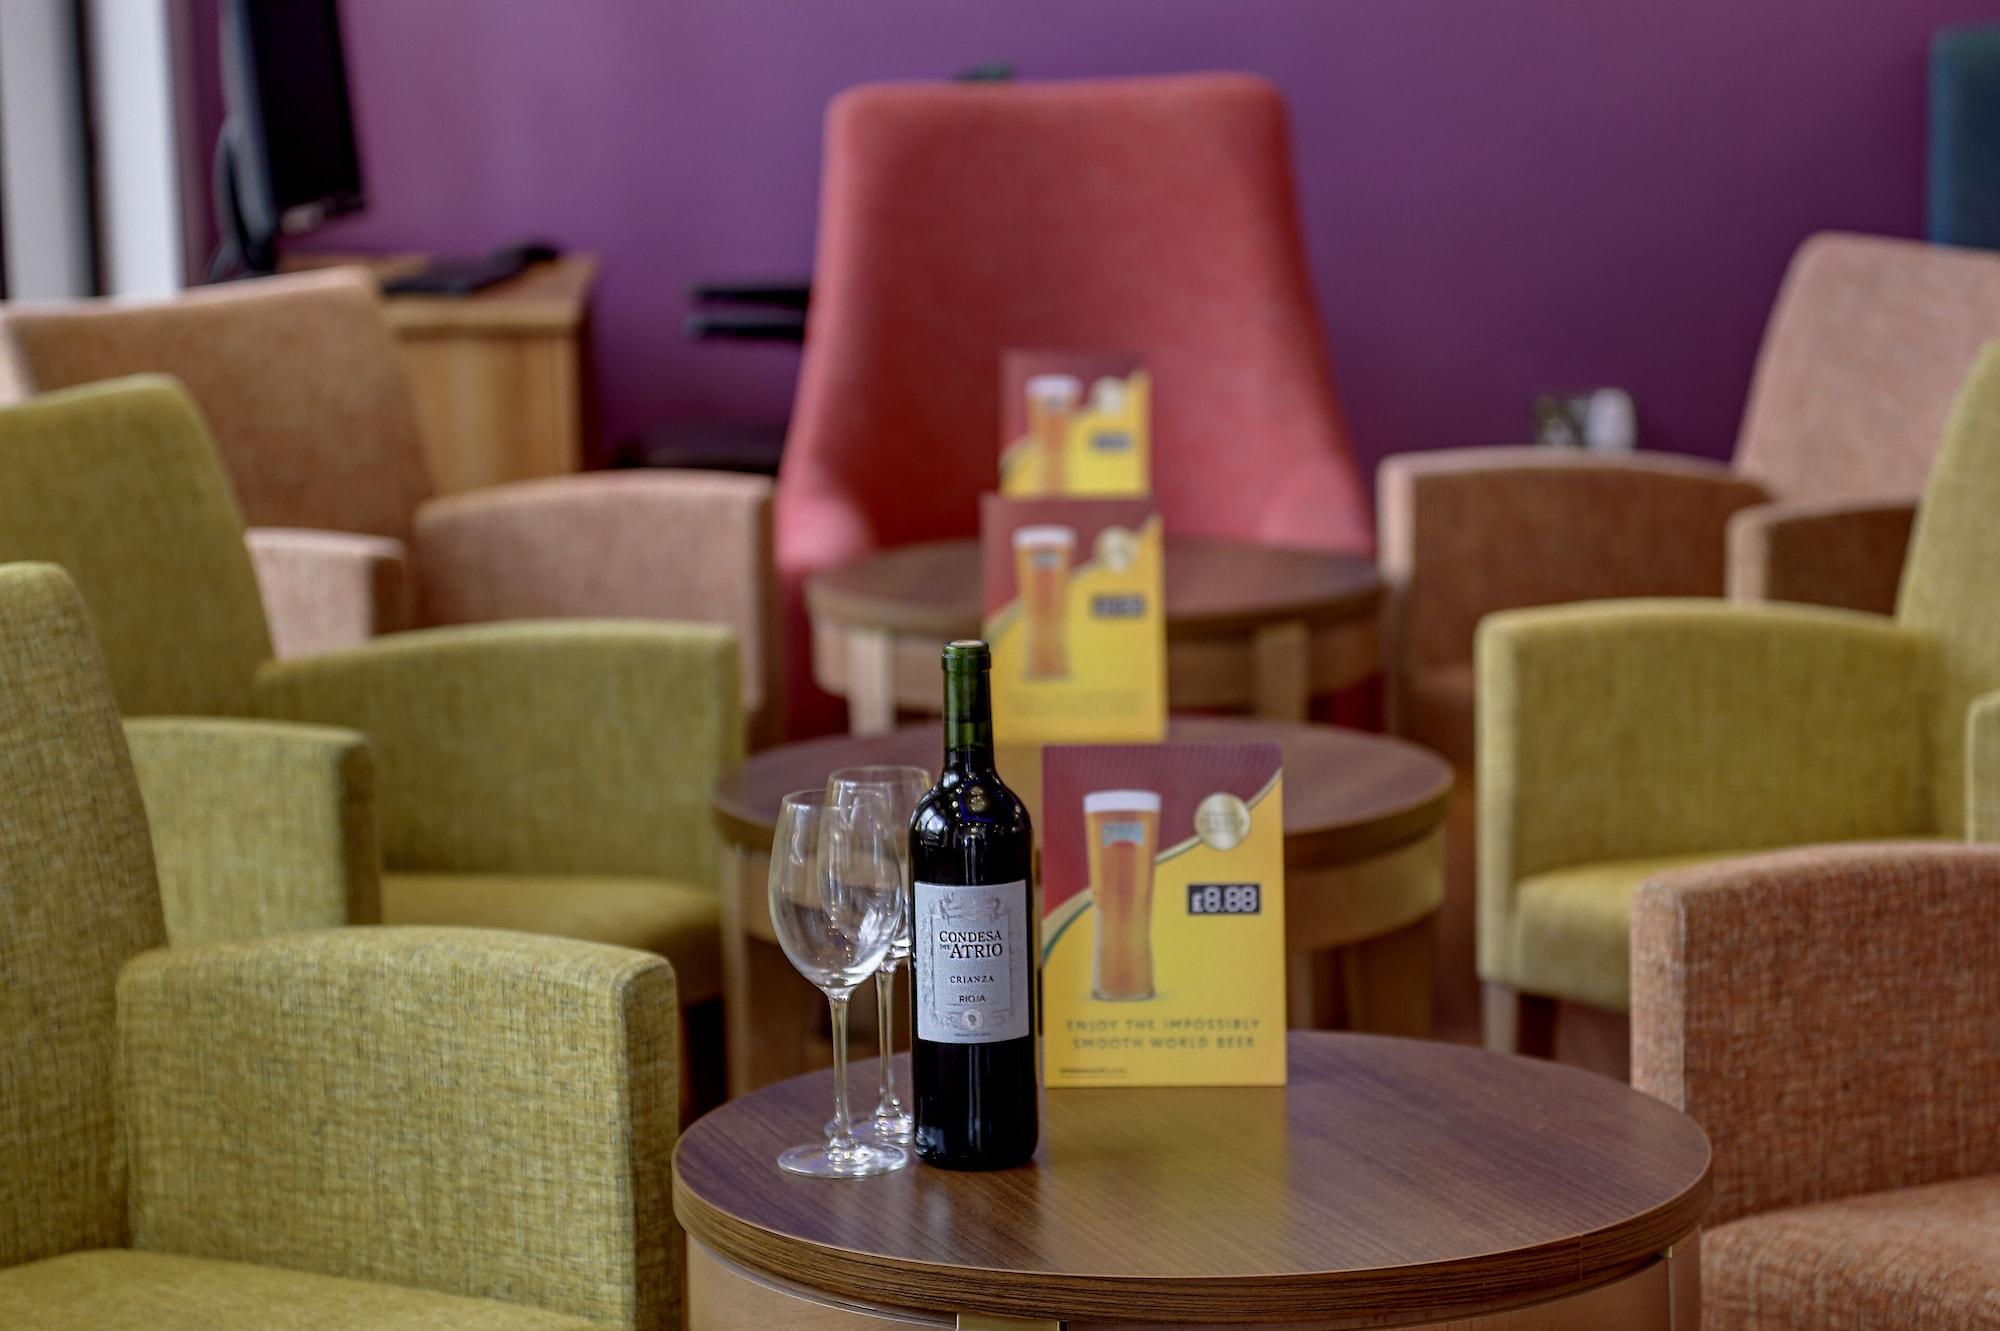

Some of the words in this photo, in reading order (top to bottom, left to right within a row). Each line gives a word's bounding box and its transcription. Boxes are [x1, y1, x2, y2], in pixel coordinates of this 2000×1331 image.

[939, 930, 1002, 942] CONDESA
[950, 943, 1003, 959] ATRIO
[950, 975, 994, 984] CRIANZA
[959, 995, 986, 1003] RIOJA
[1066, 1019, 1118, 1032] ENJOY
[1125, 1019, 1155, 1030] THE
[1163, 1018, 1260, 1030] IMPOSSIBLY
[1073, 1037, 1143, 1049] SMOOTH
[1151, 1037, 1209, 1049] WORLD
[1216, 1036, 1255, 1048] BEER
